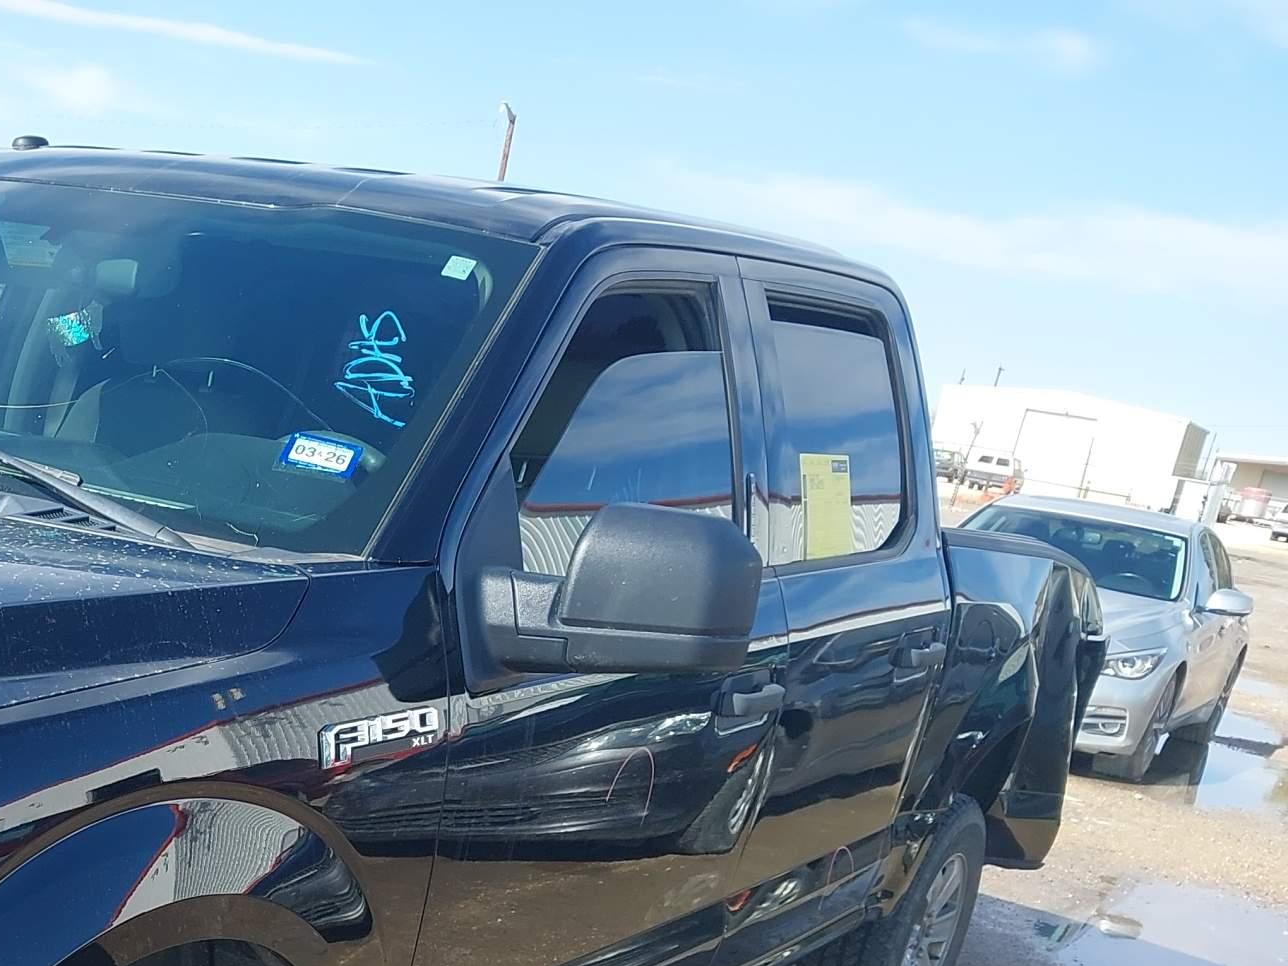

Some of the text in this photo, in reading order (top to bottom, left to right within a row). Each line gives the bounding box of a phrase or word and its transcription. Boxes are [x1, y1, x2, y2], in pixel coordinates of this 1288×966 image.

[294, 443, 348, 466] 03 26
[411, 732, 435, 749] XLT
